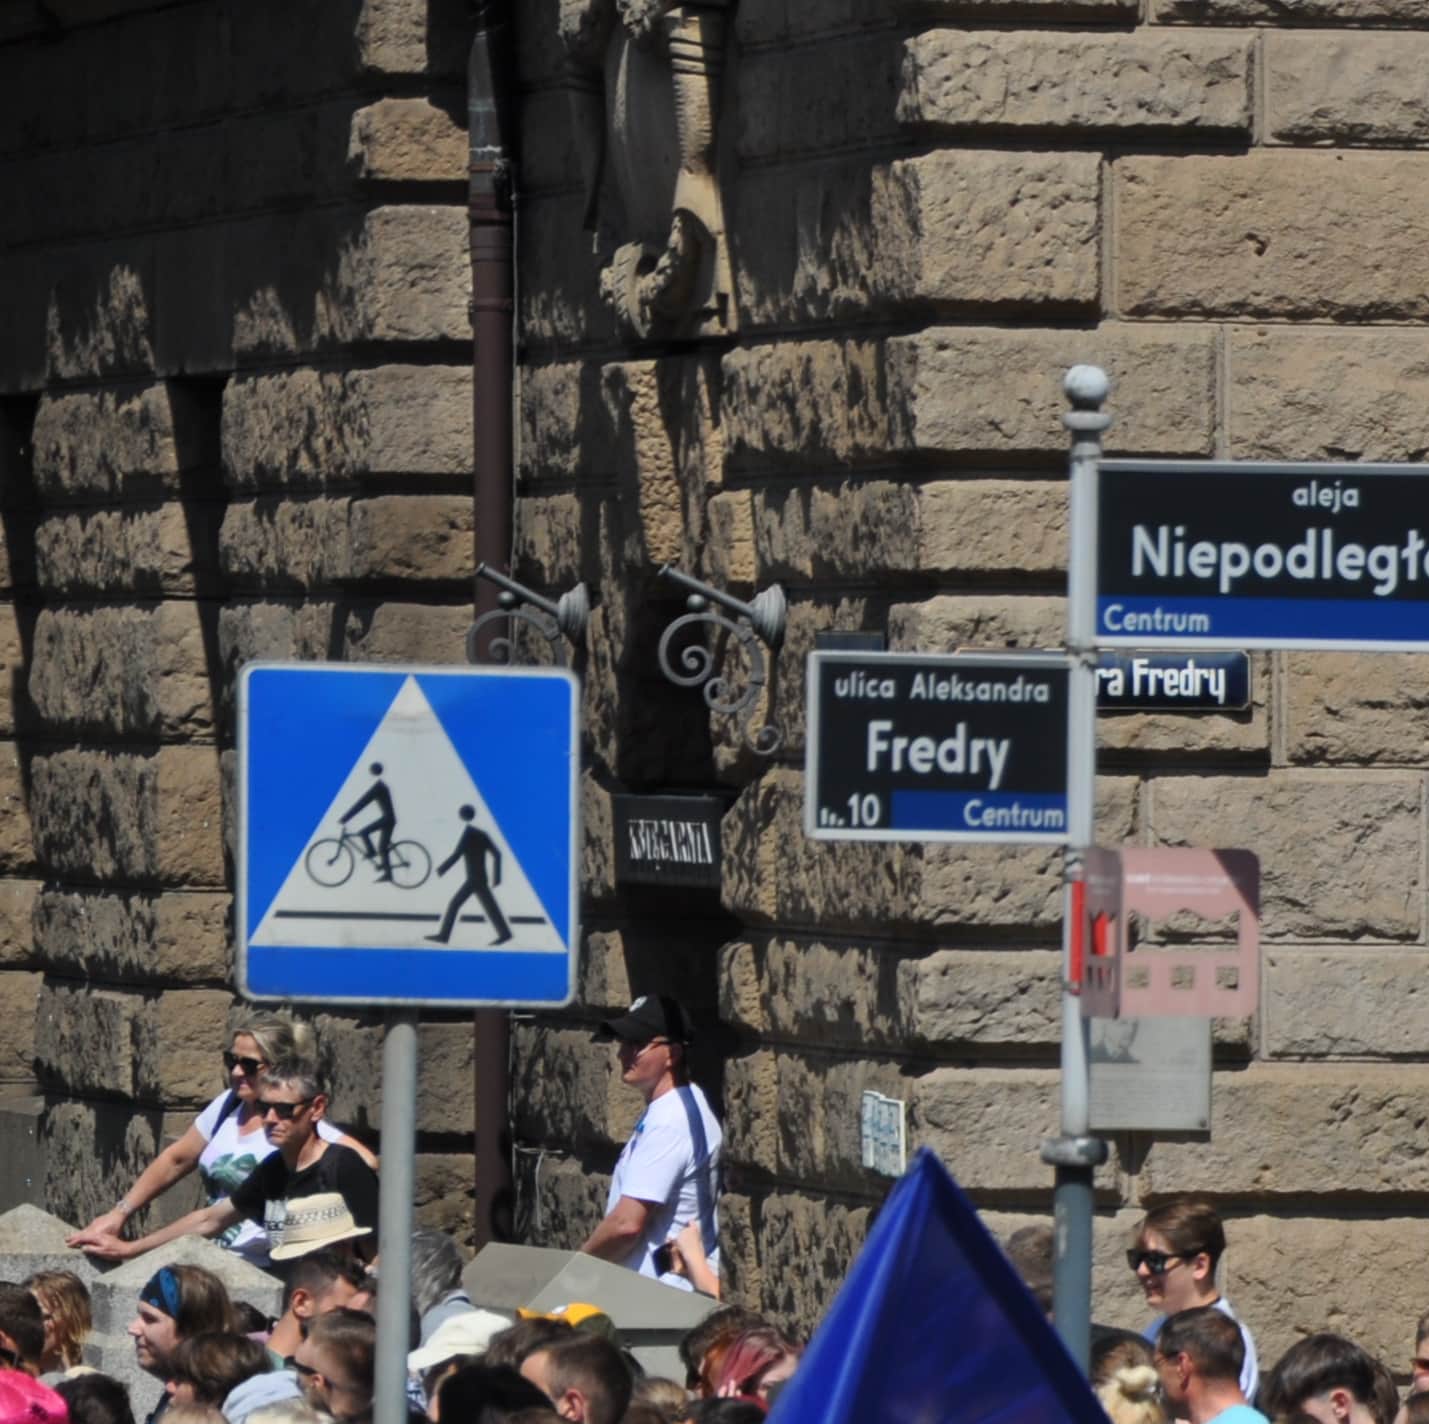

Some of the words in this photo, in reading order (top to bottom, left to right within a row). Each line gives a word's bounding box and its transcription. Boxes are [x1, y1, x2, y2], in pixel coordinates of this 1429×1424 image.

[1292, 480, 1360, 513] aleja
[1103, 605, 1210, 634] Centrum
[834, 674, 896, 702] ulica
[909, 674, 1050, 704] Aleksandra
[1132, 658, 1226, 705] Fredry
[866, 720, 1011, 791] Fredry
[963, 799, 1065, 829] Centrum
